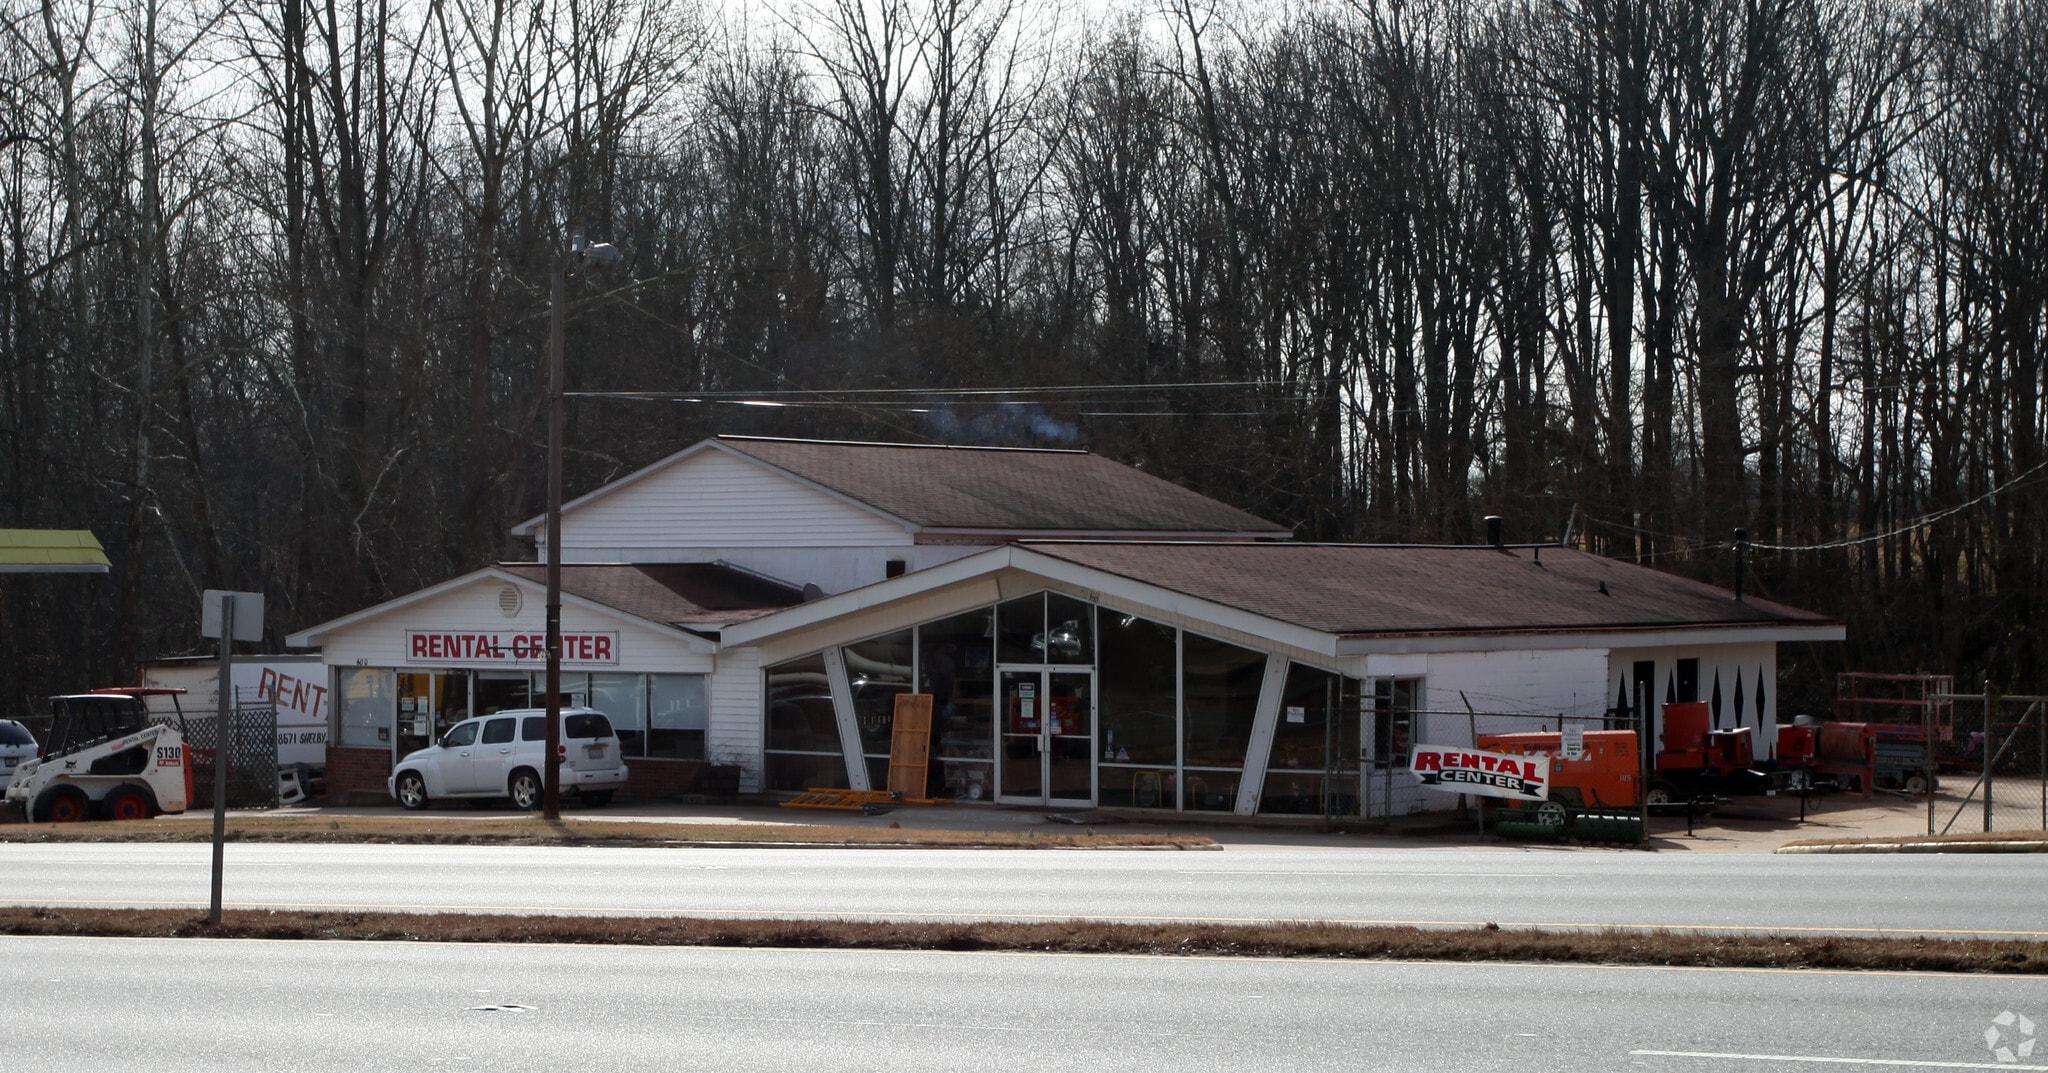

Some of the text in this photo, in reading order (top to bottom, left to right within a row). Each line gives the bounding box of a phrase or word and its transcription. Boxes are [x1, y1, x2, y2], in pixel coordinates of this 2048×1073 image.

[412, 634, 611, 660] RENTAL CETER
[157, 747, 181, 759] S130
[1414, 752, 1544, 783] RENTAL
[1440, 772, 1520, 789] CENTER
